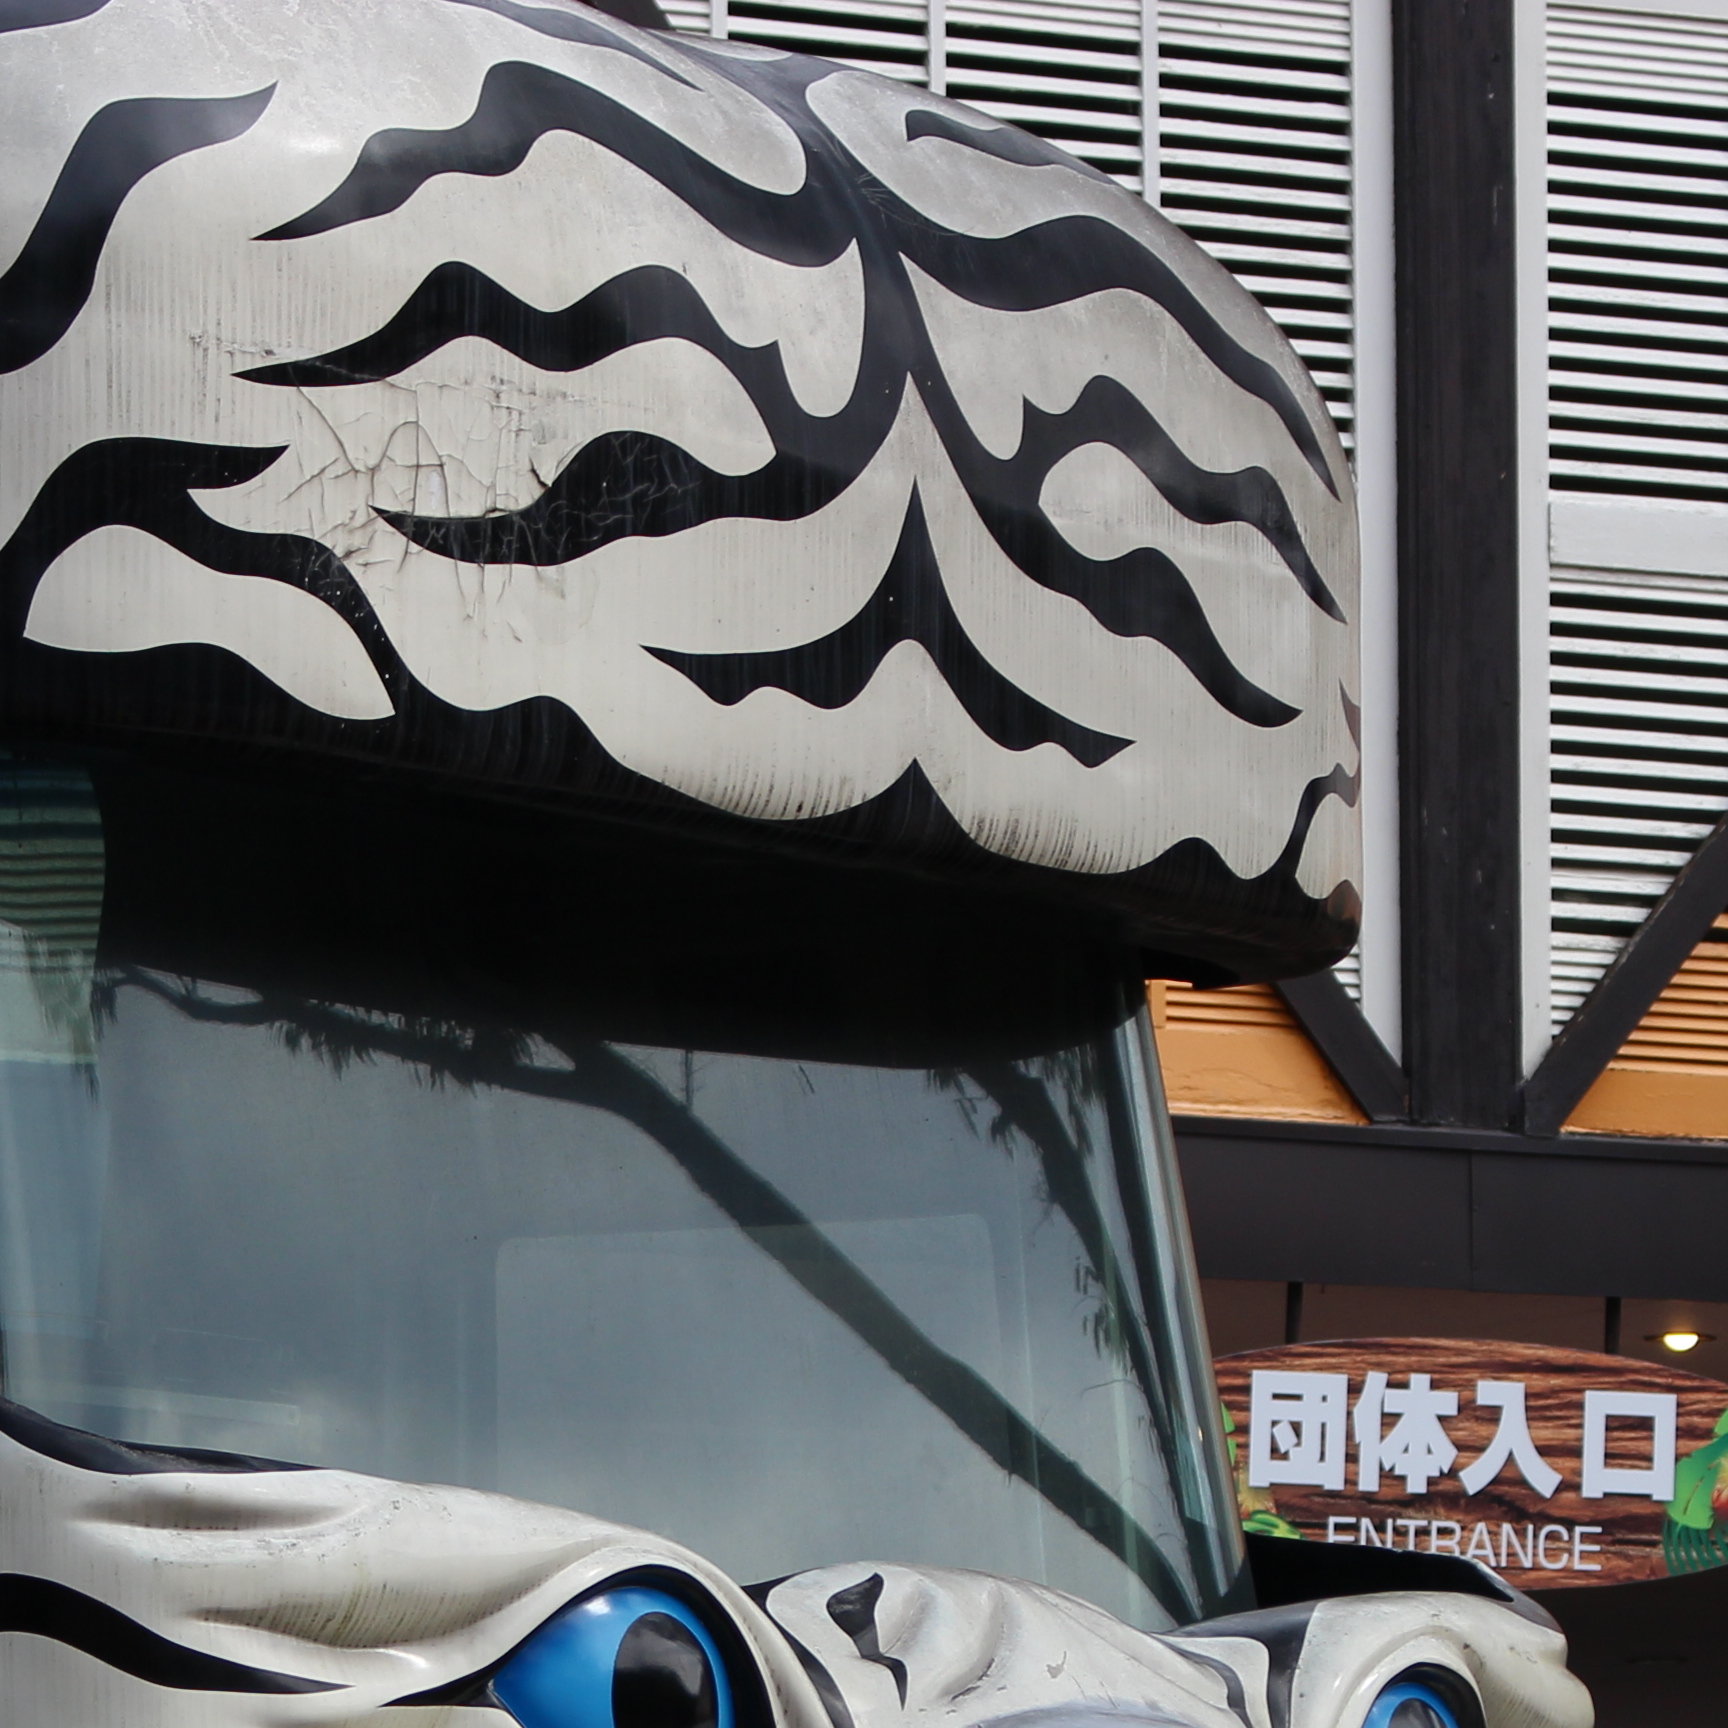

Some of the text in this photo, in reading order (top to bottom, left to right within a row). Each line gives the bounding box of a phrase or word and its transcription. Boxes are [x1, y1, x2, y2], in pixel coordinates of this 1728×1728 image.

[1248, 1369, 1677, 1501] 団体入口
[1327, 1516, 1603, 1571] ENTRANCE
